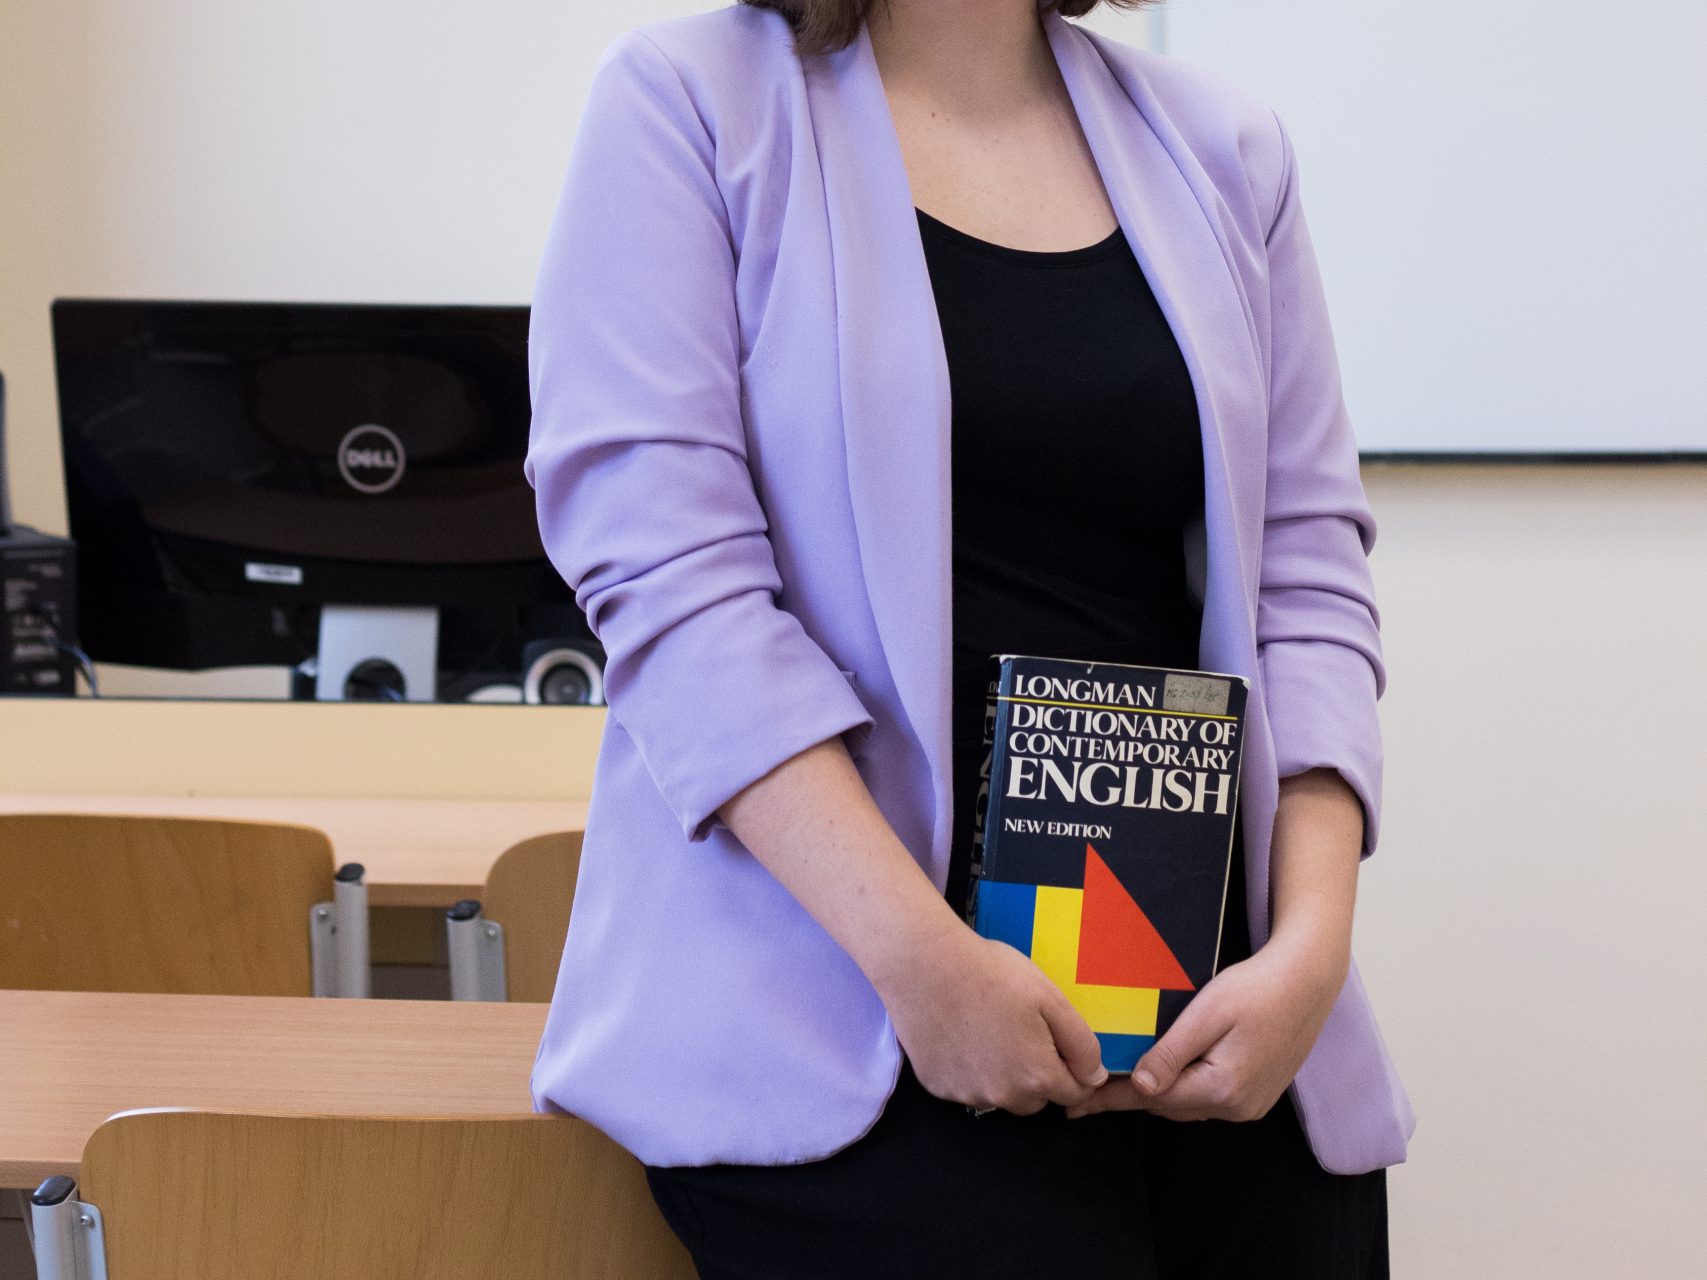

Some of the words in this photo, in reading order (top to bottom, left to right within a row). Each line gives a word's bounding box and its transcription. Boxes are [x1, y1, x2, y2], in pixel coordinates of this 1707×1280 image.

[347, 449, 396, 468] DELL
[1014, 674, 1156, 707] LONGMAN
[1011, 704, 1197, 742] DICTIONARY
[1199, 720, 1238, 746] OF
[1009, 731, 1236, 770] CONTEMPORARY
[1005, 755, 1233, 815] ENGLISH
[1004, 817, 1045, 834] NEW
[1047, 821, 1113, 840] EDITION
